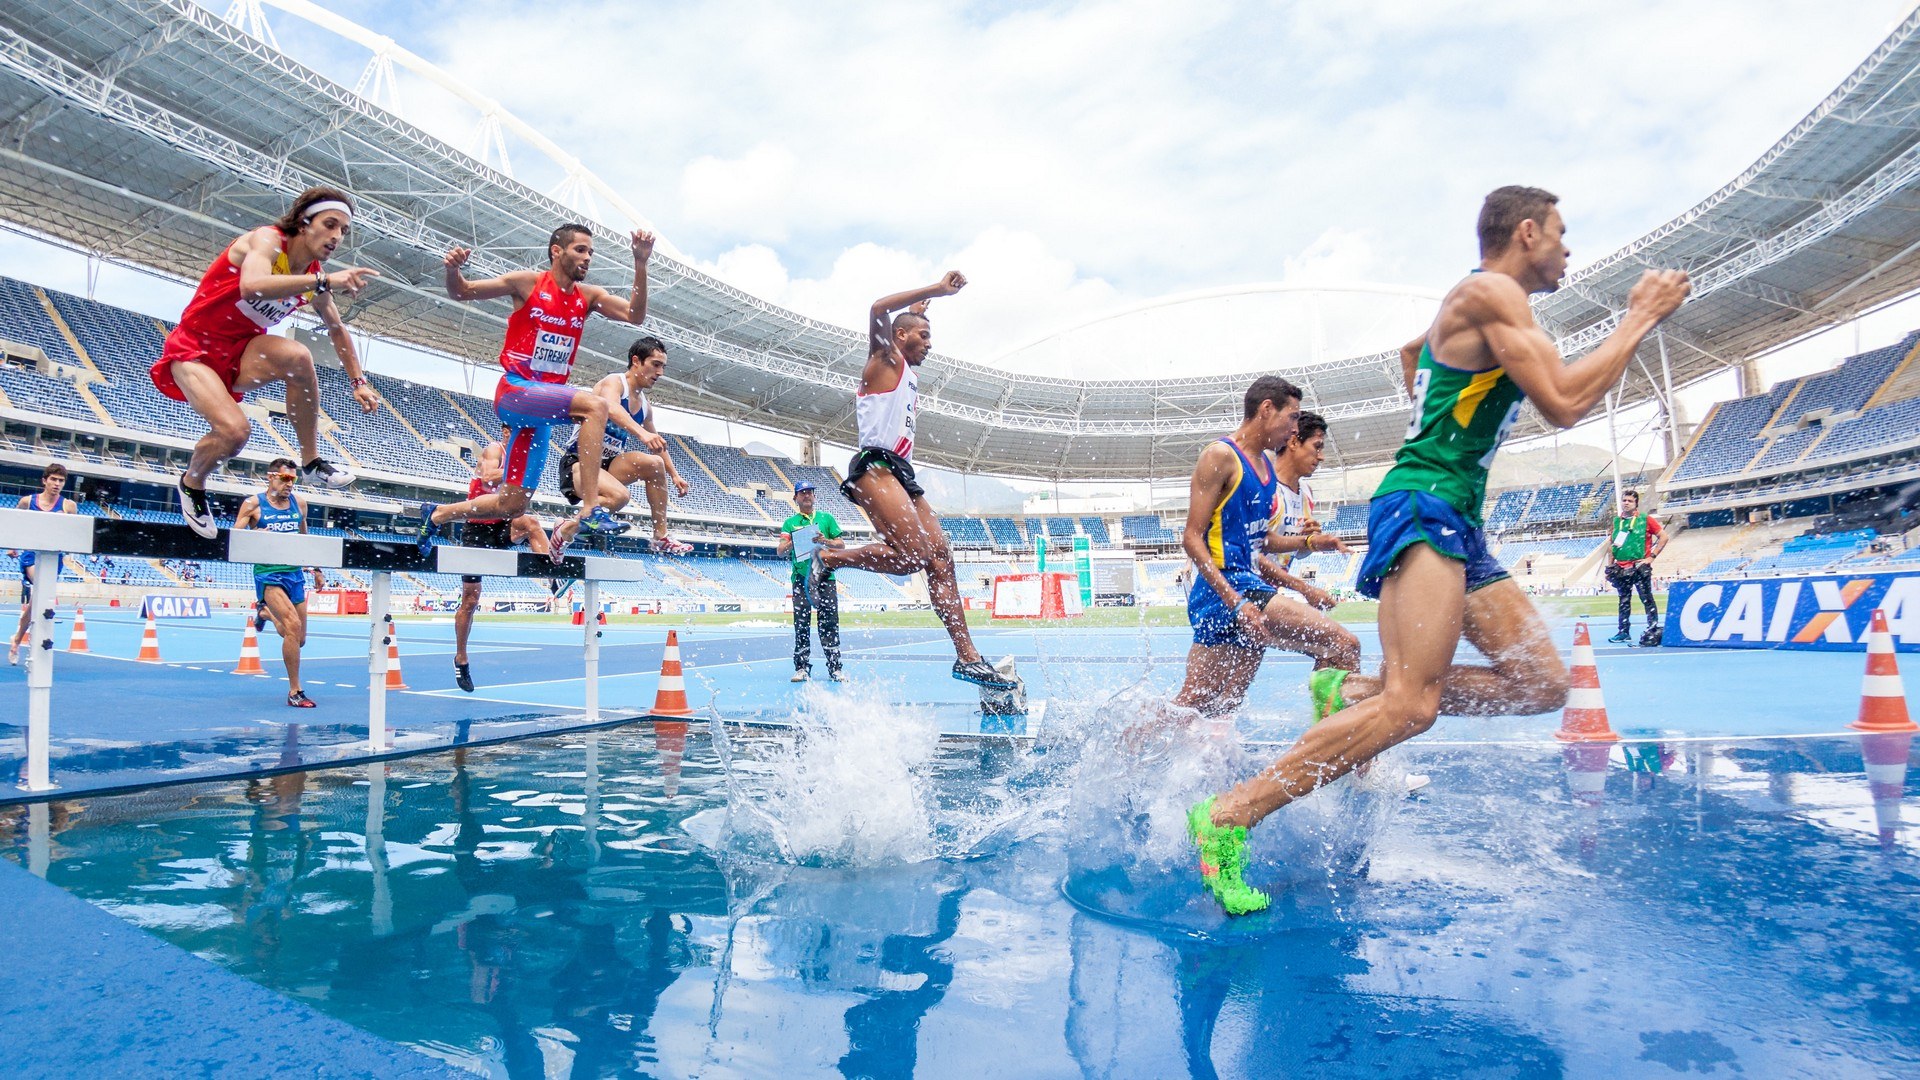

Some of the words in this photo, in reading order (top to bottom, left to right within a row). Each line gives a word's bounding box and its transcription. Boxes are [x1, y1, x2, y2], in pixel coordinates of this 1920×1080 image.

[529, 307, 567, 326] Puerto
[570, 316, 583, 329] Ric
[1284, 516, 1306, 527] CAIX
[151, 597, 208, 617] CAIXA
[1679, 577, 1920, 644] CAIXA
